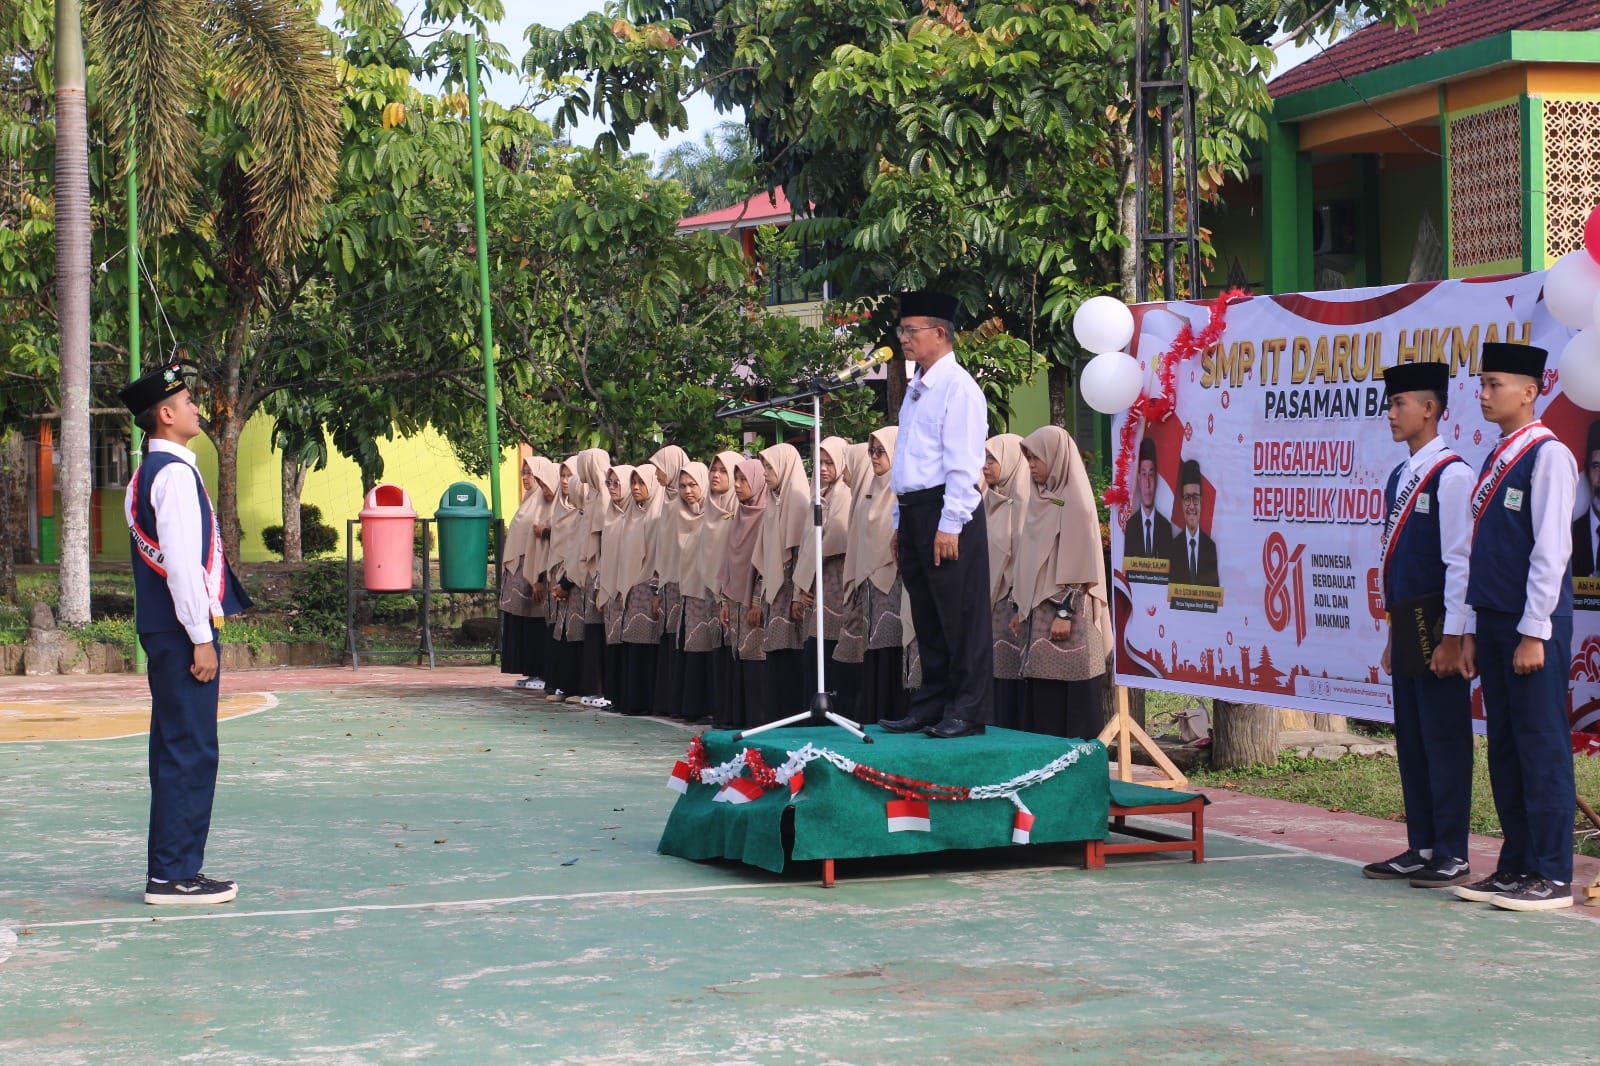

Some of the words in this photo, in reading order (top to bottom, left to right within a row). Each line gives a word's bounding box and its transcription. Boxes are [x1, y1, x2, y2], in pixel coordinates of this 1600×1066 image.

[1200, 341, 1255, 388] SMP
[1260, 337, 1287, 386] IT
[1291, 331, 1390, 384] DARUL
[1265, 387, 1360, 419] PASAMAN
[1366, 386, 1389, 417] BA
[1253, 440, 1353, 475] DIRGAHAYU
[1391, 474, 1421, 517] PETUGAS
[1477, 459, 1507, 503] PETUGAS
[1253, 486, 1335, 523] REPUBLIK
[157, 553, 164, 564] U
[1311, 553, 1352, 569] INDONESIA
[1262, 531, 1307, 647] 81
[1312, 573, 1356, 589] BERDAULAT
[1314, 593, 1332, 608] ADIL
[1332, 595, 1349, 609] DAN
[1315, 613, 1350, 629] MAKMUR
